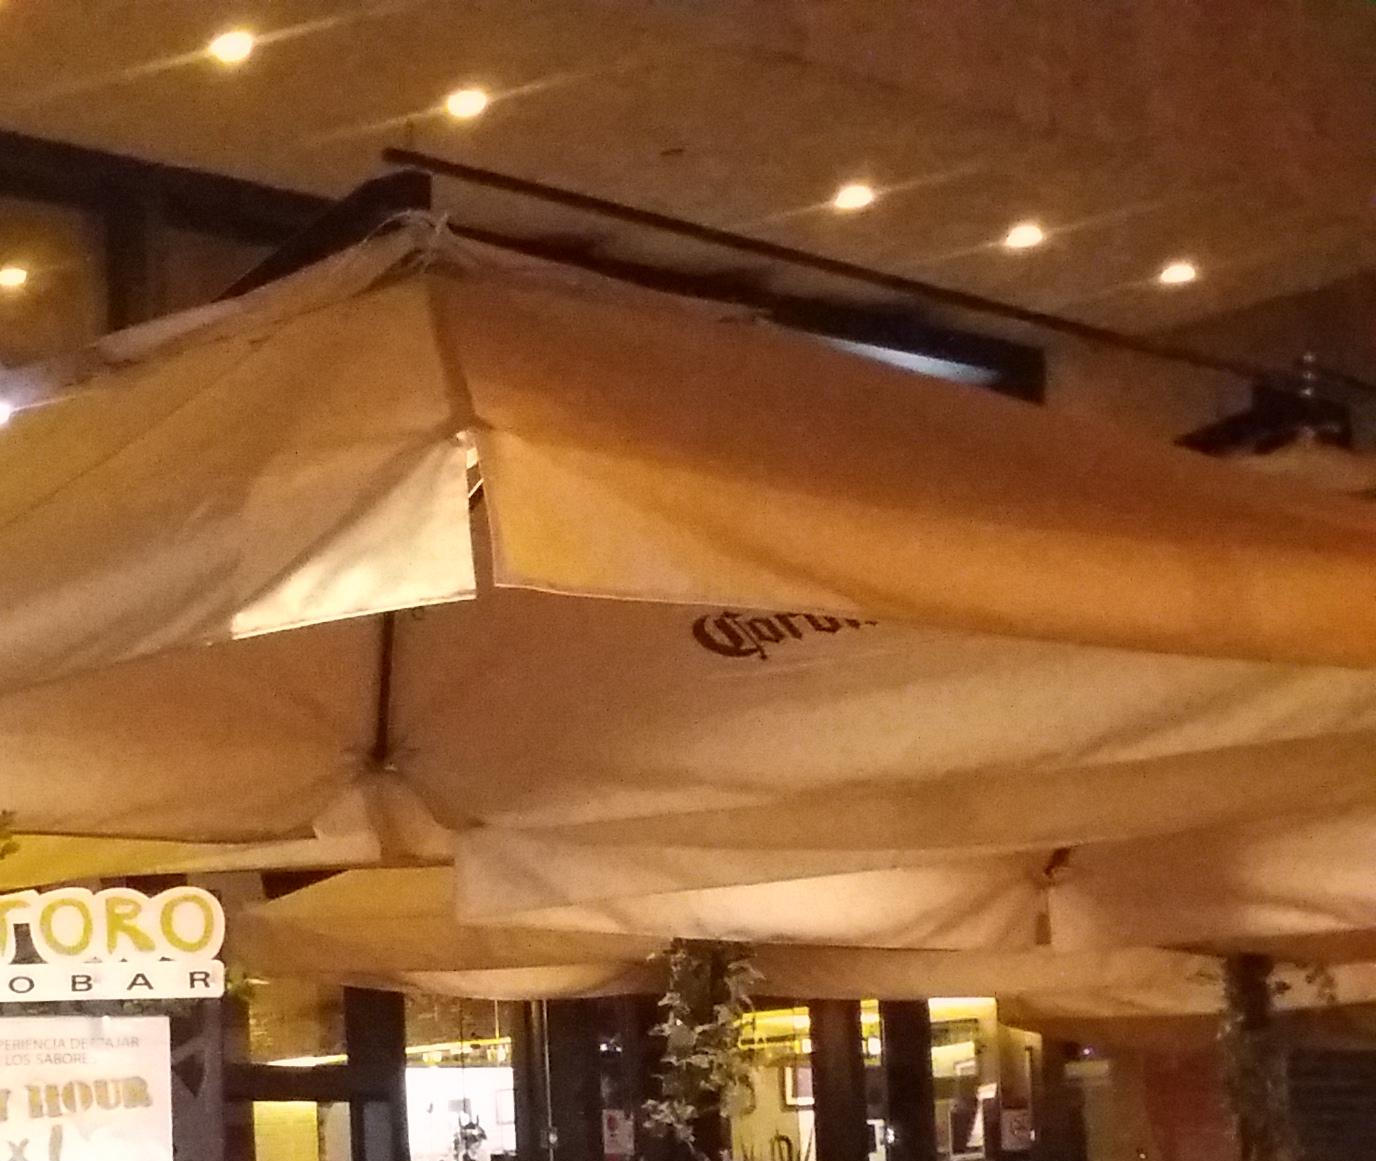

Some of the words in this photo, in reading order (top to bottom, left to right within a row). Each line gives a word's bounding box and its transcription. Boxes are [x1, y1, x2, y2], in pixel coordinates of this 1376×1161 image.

[692, 610, 880, 661] Coro
[90, 1035, 141, 1049] AJAR
[35, 1052, 97, 1066] SABORE
[25, 1075, 155, 1120] HOUR
